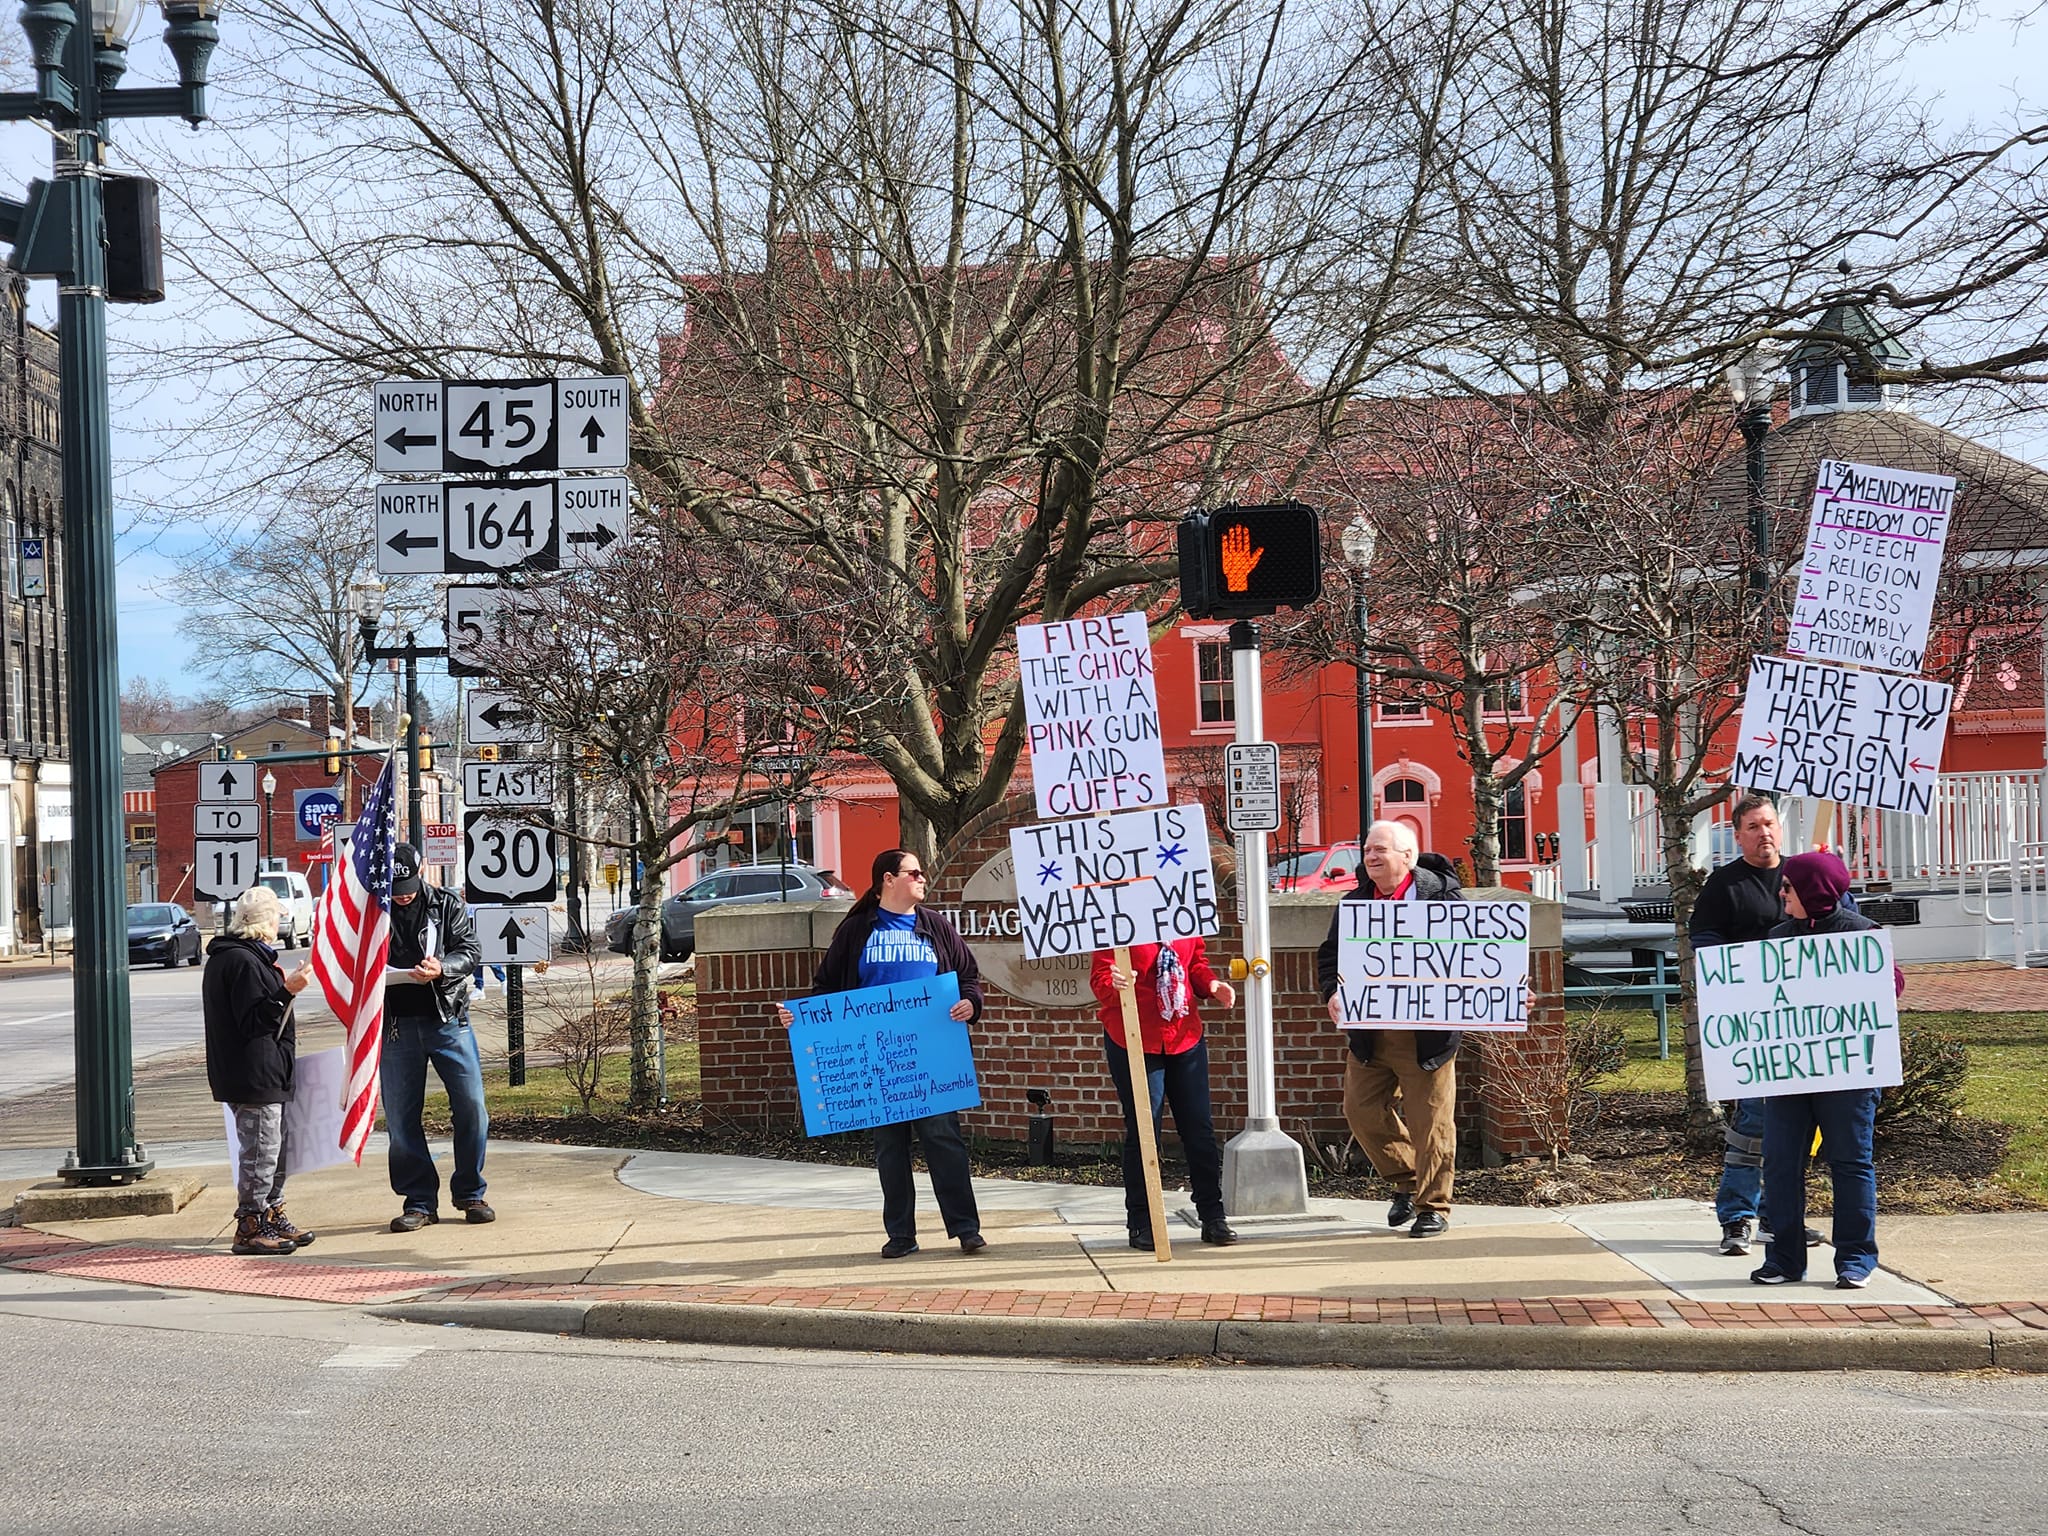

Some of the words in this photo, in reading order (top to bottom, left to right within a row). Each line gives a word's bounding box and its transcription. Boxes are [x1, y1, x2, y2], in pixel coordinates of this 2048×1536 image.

[380, 393, 438, 412] NORTH
[564, 389, 621, 409] SOUTH
[459, 400, 536, 448] 45
[381, 495, 439, 514] NORTH
[564, 489, 621, 510] SOUTH
[1834, 469, 1953, 513] AMENDMENT
[465, 501, 535, 549] 164
[1821, 499, 1904, 534] FREEDOM
[1913, 516, 1944, 540] OF
[1834, 530, 1917, 562] SPEECH
[1829, 554, 1921, 590] RELIGION
[1827, 581, 1903, 614] PRESS
[1043, 615, 1130, 653] FIRE
[1812, 607, 1912, 644] ASSEMBLY
[1022, 656, 1073, 687] THE
[1078, 647, 1153, 681] CHICK
[1809, 631, 1876, 661] PETITION
[1889, 646, 1924, 671] GOV
[1035, 684, 1112, 719] WITH
[1127, 678, 1151, 710] A
[1878, 676, 1948, 716] YOU
[1028, 719, 1096, 754] PINK
[1104, 711, 1159, 743] GUN
[1768, 693, 1857, 738] HAVE
[1068, 747, 1127, 781] AND
[1779, 728, 1908, 779] RESIGN
[478, 769, 540, 797] EAST
[1047, 773, 1153, 815] CUFF'S
[212, 811, 242, 828] TO
[305, 803, 337, 814] save
[428, 825, 455, 837] STOP
[1025, 818, 1115, 858] THIS
[1154, 810, 1186, 842] IS
[213, 852, 239, 886] 11
[481, 829, 540, 879] 30
[1075, 847, 1149, 885] NOT
[1020, 882, 1130, 925] WHAT
[1153, 869, 1207, 907] WE
[1024, 913, 1136, 957] VOTED
[1153, 902, 1219, 941] FOR
[1343, 903, 1413, 939] THE
[1427, 903, 1527, 940] PRESS
[1019, 954, 1090, 970] FOUNDE
[1363, 942, 1502, 979] SERVES
[1699, 944, 1745, 986] WE
[1760, 936, 1884, 983] DEMAND
[799, 999, 833, 1025] First
[843, 986, 932, 1020] Amendment
[1046, 979, 1078, 995] 1803
[1387, 984, 1435, 1020] THE
[1773, 984, 1790, 1006] A
[813, 1037, 853, 1056] Freedom
[857, 1035, 867, 1050] of
[876, 1030, 918, 1047] Religion
[1704, 1001, 1893, 1049] CONSTITUTIONAL
[816, 1054, 856, 1070] Freedom
[860, 1054, 870, 1064] of
[878, 1044, 918, 1063] Speech
[819, 1068, 858, 1084] Freedom
[860, 1066, 869, 1077] of
[872, 1064, 886, 1076] the
[890, 1059, 917, 1073] Press
[1732, 1034, 1876, 1085] SHERIFF!
[821, 1081, 859, 1097] Freedom
[864, 1078, 873, 1090] of
[879, 1071, 929, 1088] Expression
[825, 1095, 866, 1112] Freedom
[869, 1093, 878, 1106] to
[881, 1084, 927, 1104] Peaceably
[930, 1073, 975, 1096] Assemble
[828, 1110, 867, 1131] Freedom
[870, 1110, 881, 1123] to
[883, 1104, 931, 1122] Petition
